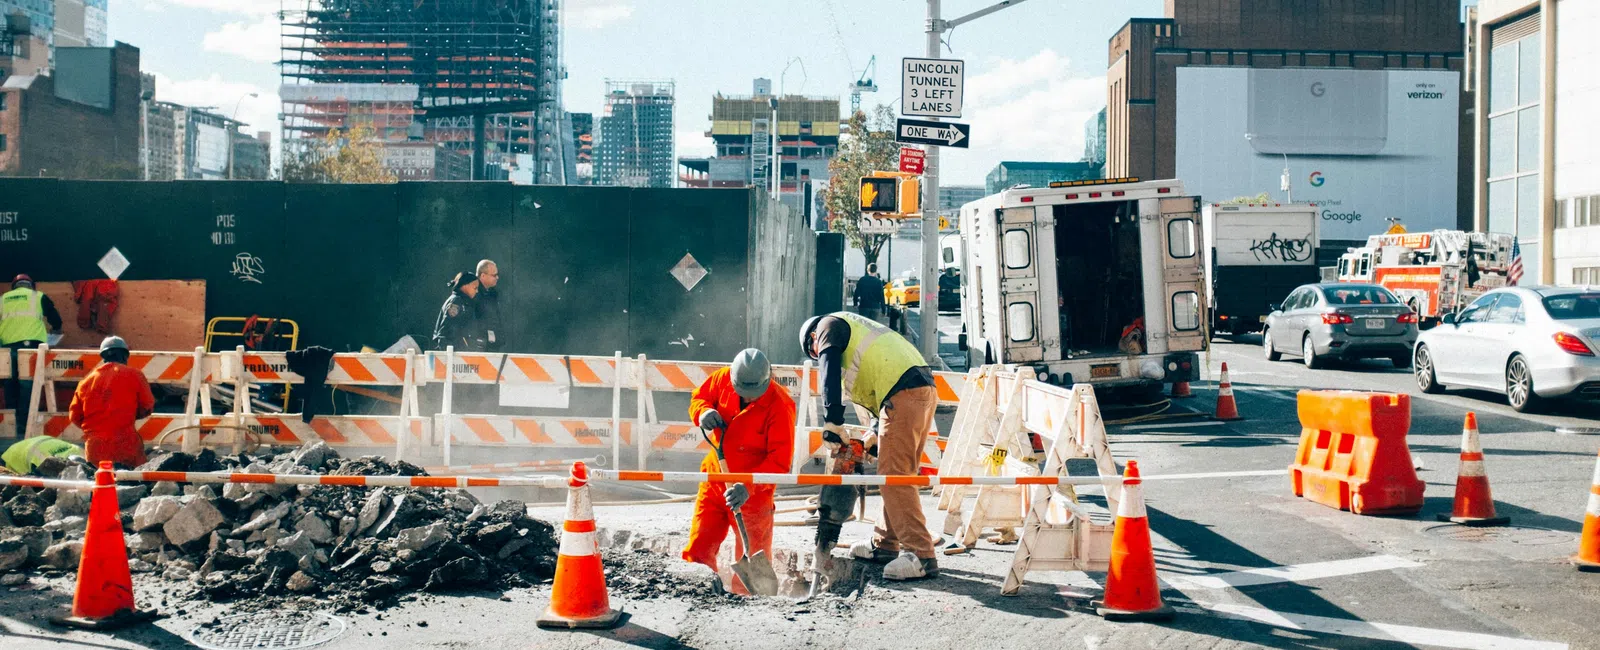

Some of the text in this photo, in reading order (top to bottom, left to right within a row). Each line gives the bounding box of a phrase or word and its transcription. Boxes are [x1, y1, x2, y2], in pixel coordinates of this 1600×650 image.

[907, 63, 959, 74] LINCOLN
[909, 75, 956, 87] TUNNEL
[911, 88, 954, 99] 3 LEFT
[1407, 90, 1442, 99] verizon
[912, 101, 952, 112] LANES
[907, 126, 959, 140] ONE WAY
[1322, 209, 1362, 224] Google
[1, 228, 28, 241] BILLS
[52, 360, 84, 369] TRIUMPH
[452, 363, 480, 373] RIUMPH
[248, 425, 280, 435] TRIUMPH
